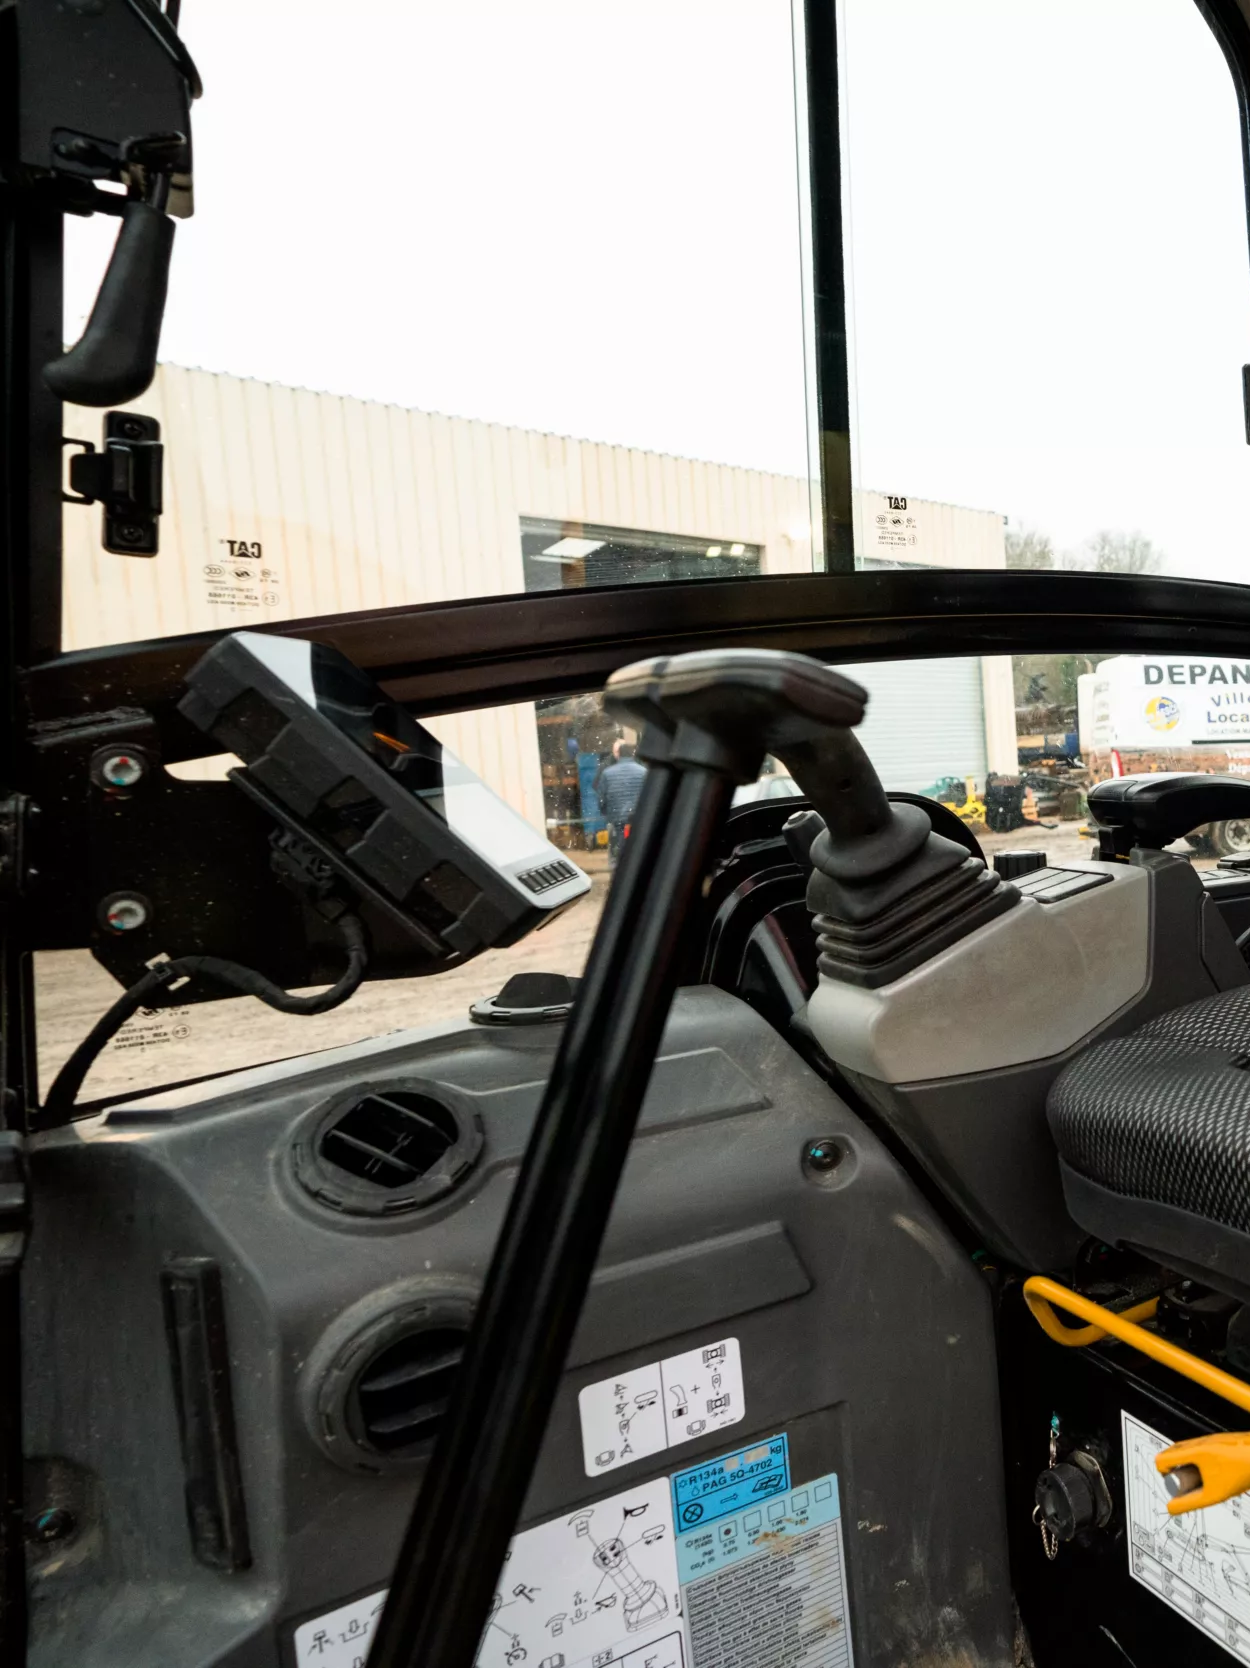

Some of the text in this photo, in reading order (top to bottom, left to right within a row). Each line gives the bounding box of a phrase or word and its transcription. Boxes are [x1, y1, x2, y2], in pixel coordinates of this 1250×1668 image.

[688, 1443, 782, 1485] R134a kg
[702, 1478, 727, 1493] PAG
